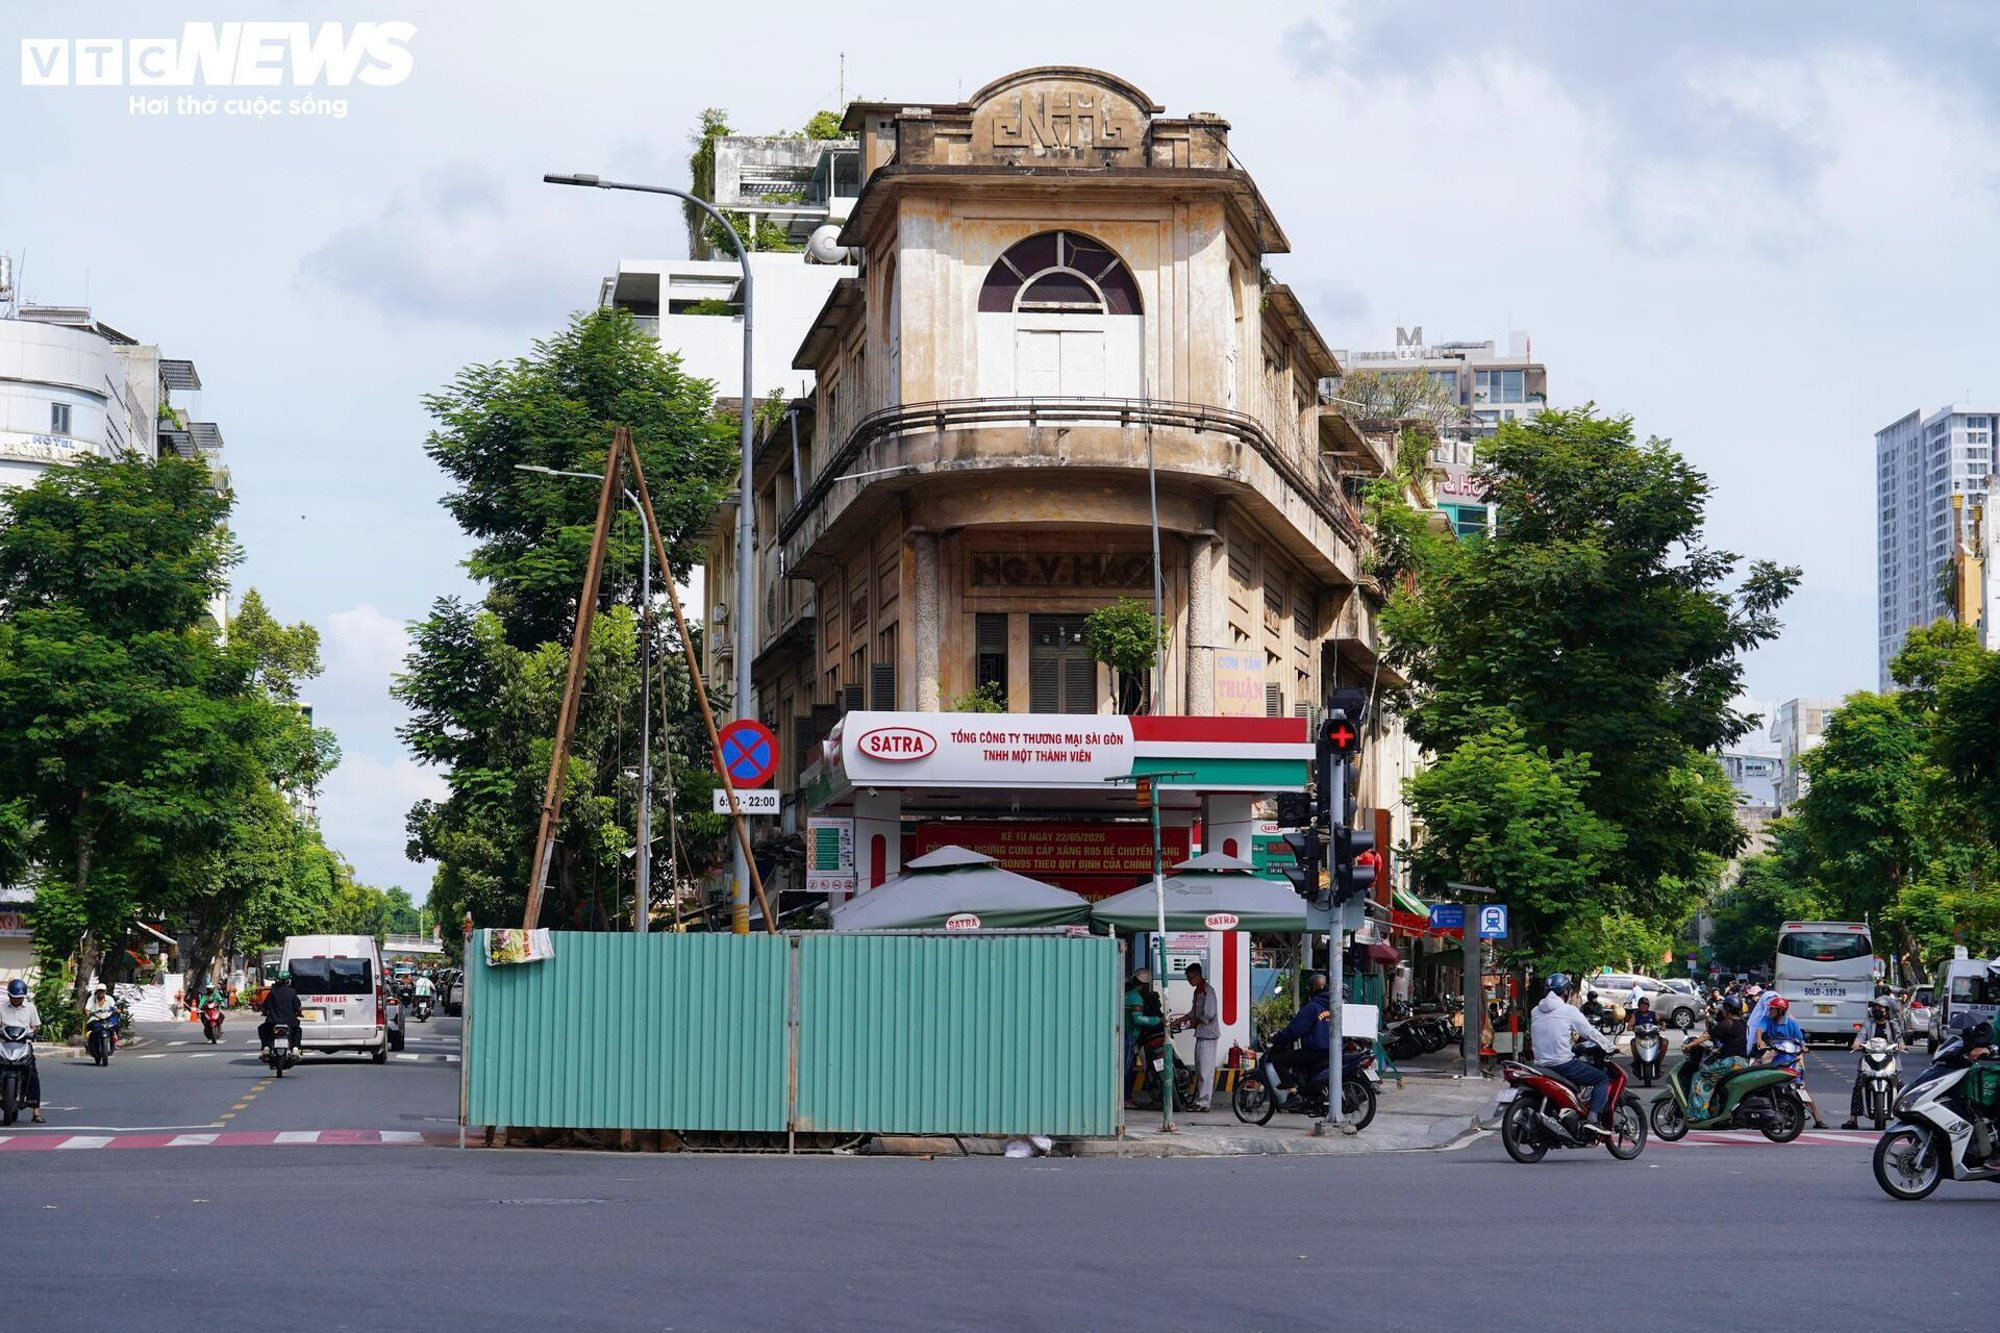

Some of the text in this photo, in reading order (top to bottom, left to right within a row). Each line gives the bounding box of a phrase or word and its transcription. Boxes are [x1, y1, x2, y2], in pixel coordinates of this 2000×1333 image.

[32, 435, 76, 450] HOTEL
[951, 728, 1124, 748] TỔNG CÔNG TY THƯƠNG MẠI SÀI GÒN
[871, 736, 924, 753] SATRA
[983, 748, 1092, 764] TNHH MỘT THÀNH VIÊN
[719, 796, 740, 807] 6:0
[748, 796, 775, 807] 22:00
[1008, 845, 1033, 855] CUNG
[1160, 846, 1180, 857] ANG
[1002, 859, 1031, 869] RON95
[1034, 860, 1056, 869] THEO
[1059, 860, 1076, 869] QUY
[949, 918, 978, 929] SATRA
[1208, 916, 1236, 926] SATRA
